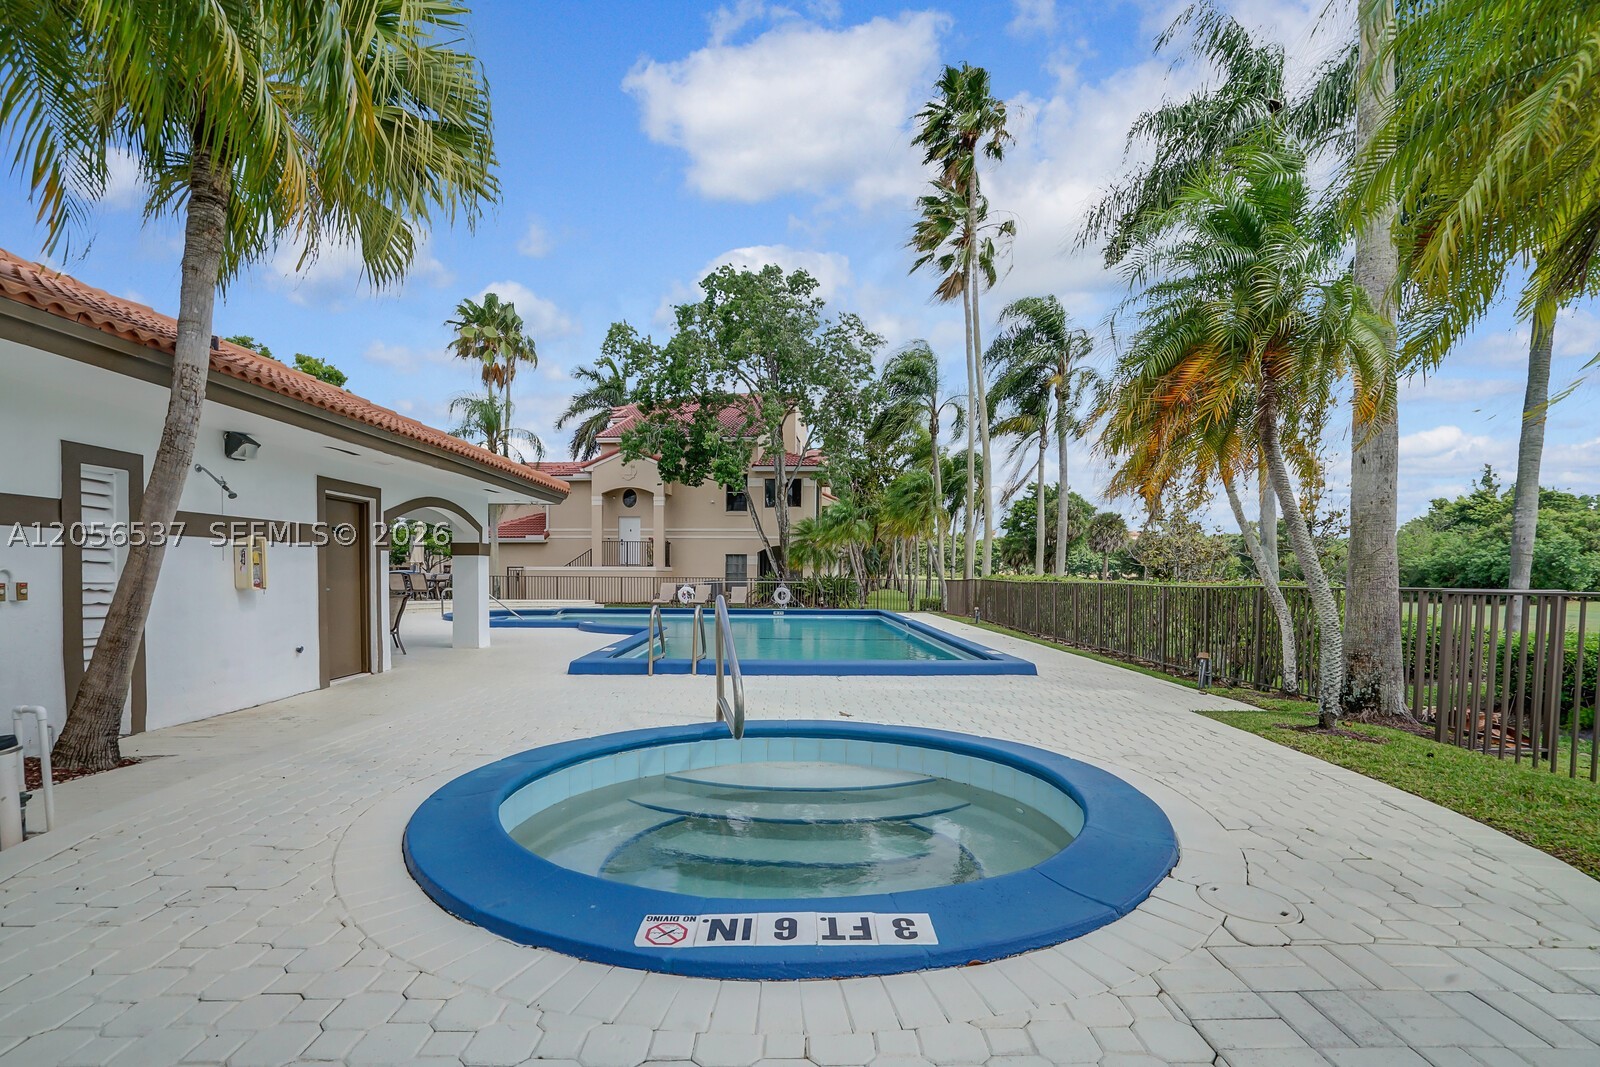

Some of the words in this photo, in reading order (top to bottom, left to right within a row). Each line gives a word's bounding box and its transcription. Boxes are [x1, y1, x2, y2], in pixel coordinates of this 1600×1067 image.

[702, 917, 751, 941] IN.
[773, 917, 798, 940] 6
[820, 916, 872, 941] FT.
[892, 917, 919, 940] 3
